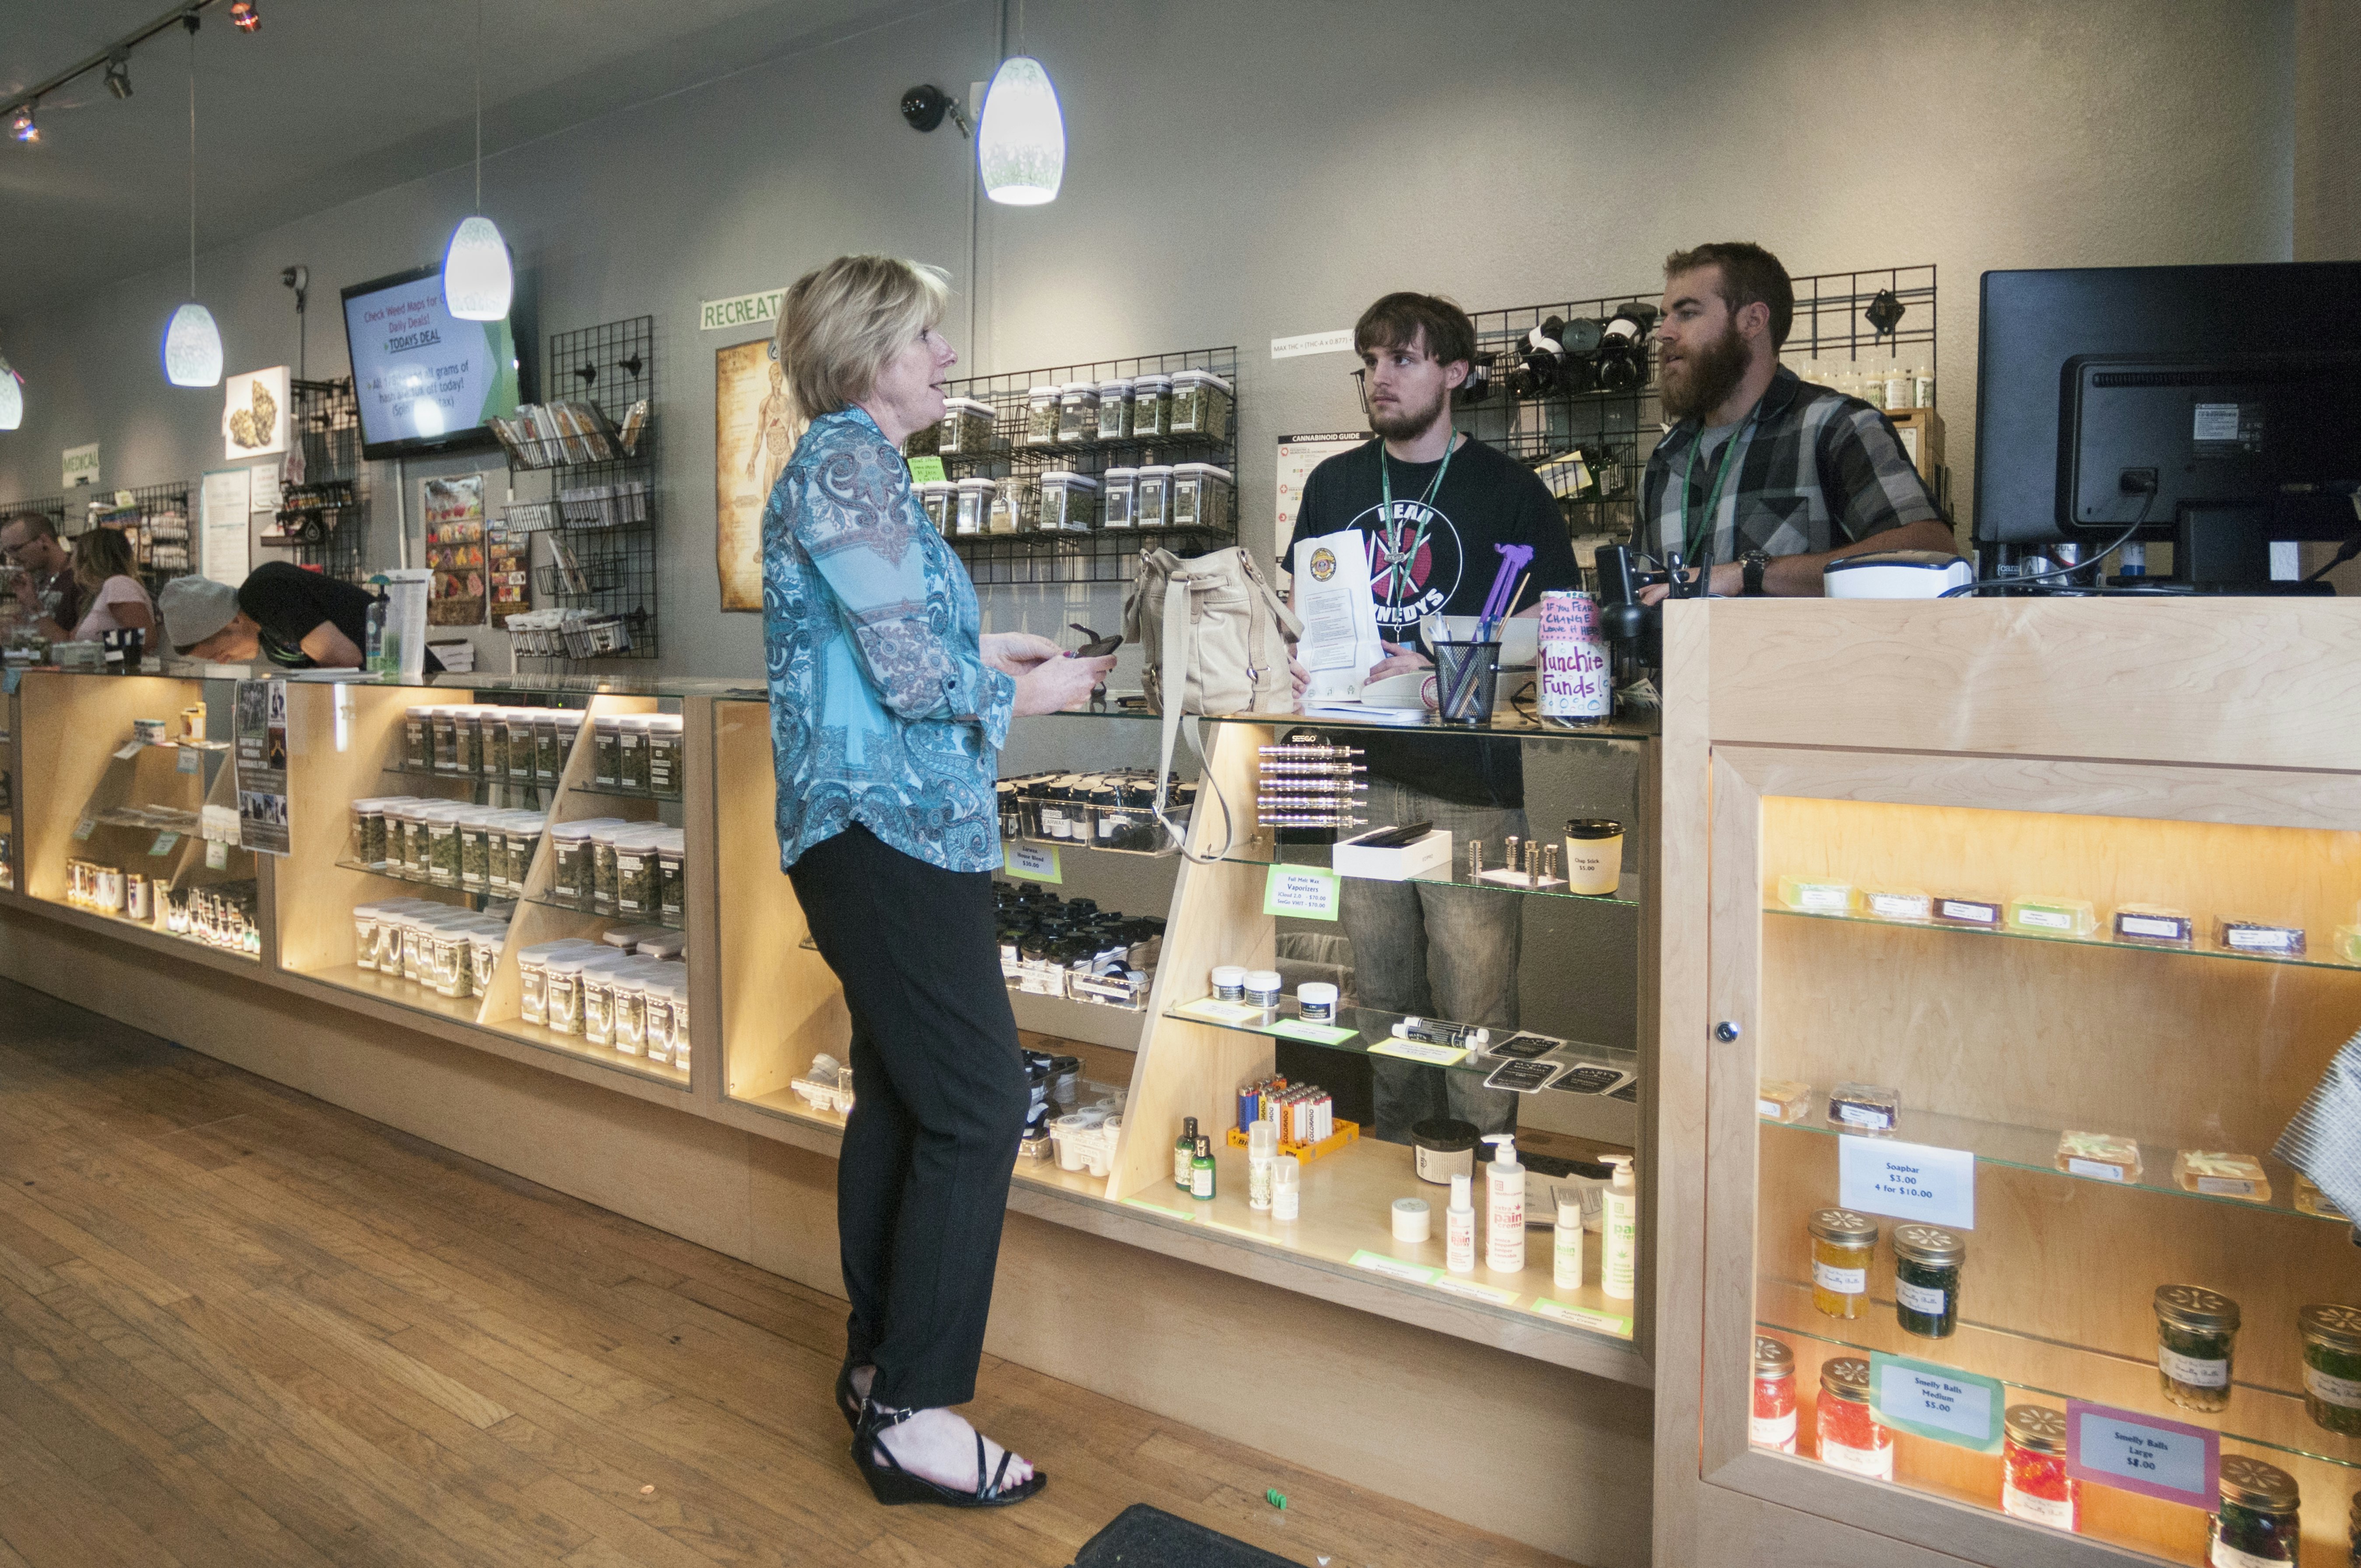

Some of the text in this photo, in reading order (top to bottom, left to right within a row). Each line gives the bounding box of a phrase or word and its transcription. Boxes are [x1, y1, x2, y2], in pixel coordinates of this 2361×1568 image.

[364, 309, 385, 323] Check
[386, 303, 405, 316] Weed
[407, 299, 425, 313] Maps
[427, 296, 437, 306] for
[389, 313, 430, 334] Daily Deals!
[389, 329, 441, 350] TODAYS DEAL
[436, 365, 459, 380] grams
[460, 359, 469, 372] of
[439, 377, 464, 393] today!
[438, 397, 454, 409] tax)
[63, 452, 98, 473] MEDICAL
[1378, 504, 1434, 525] DEAD
[1546, 603, 1554, 611] IF
[1572, 601, 1594, 612] FEAR
[1546, 614, 1591, 624] CHANGE
[1543, 624, 1566, 633] Leave
[1538, 646, 1603, 673] Munchie
[1543, 674, 1603, 699] Funds!
[1287, 884, 1319, 893] Vaporizers
[1076, 982, 1097, 991] TANGERINE
[1886, 1162, 1920, 1174] Soapbar
[1890, 1174, 1917, 1185] $3.00
[1884, 1185, 1896, 1194] for
[1899, 1187, 1933, 1199] $10.00
[1494, 1213, 1522, 1224] pain
[1613, 1224, 1636, 1234] pai
[1557, 1245, 1575, 1253] pain
[1561, 1310, 1602, 1322] Apothecanna
[1915, 1377, 1962, 1394] Smelly Balls
[1922, 1389, 1955, 1402] Medium
[1925, 1401, 1951, 1413] $5.00
[2114, 1432, 2169, 1451] Smelly Balls
[2129, 1446, 2153, 1459] Large
